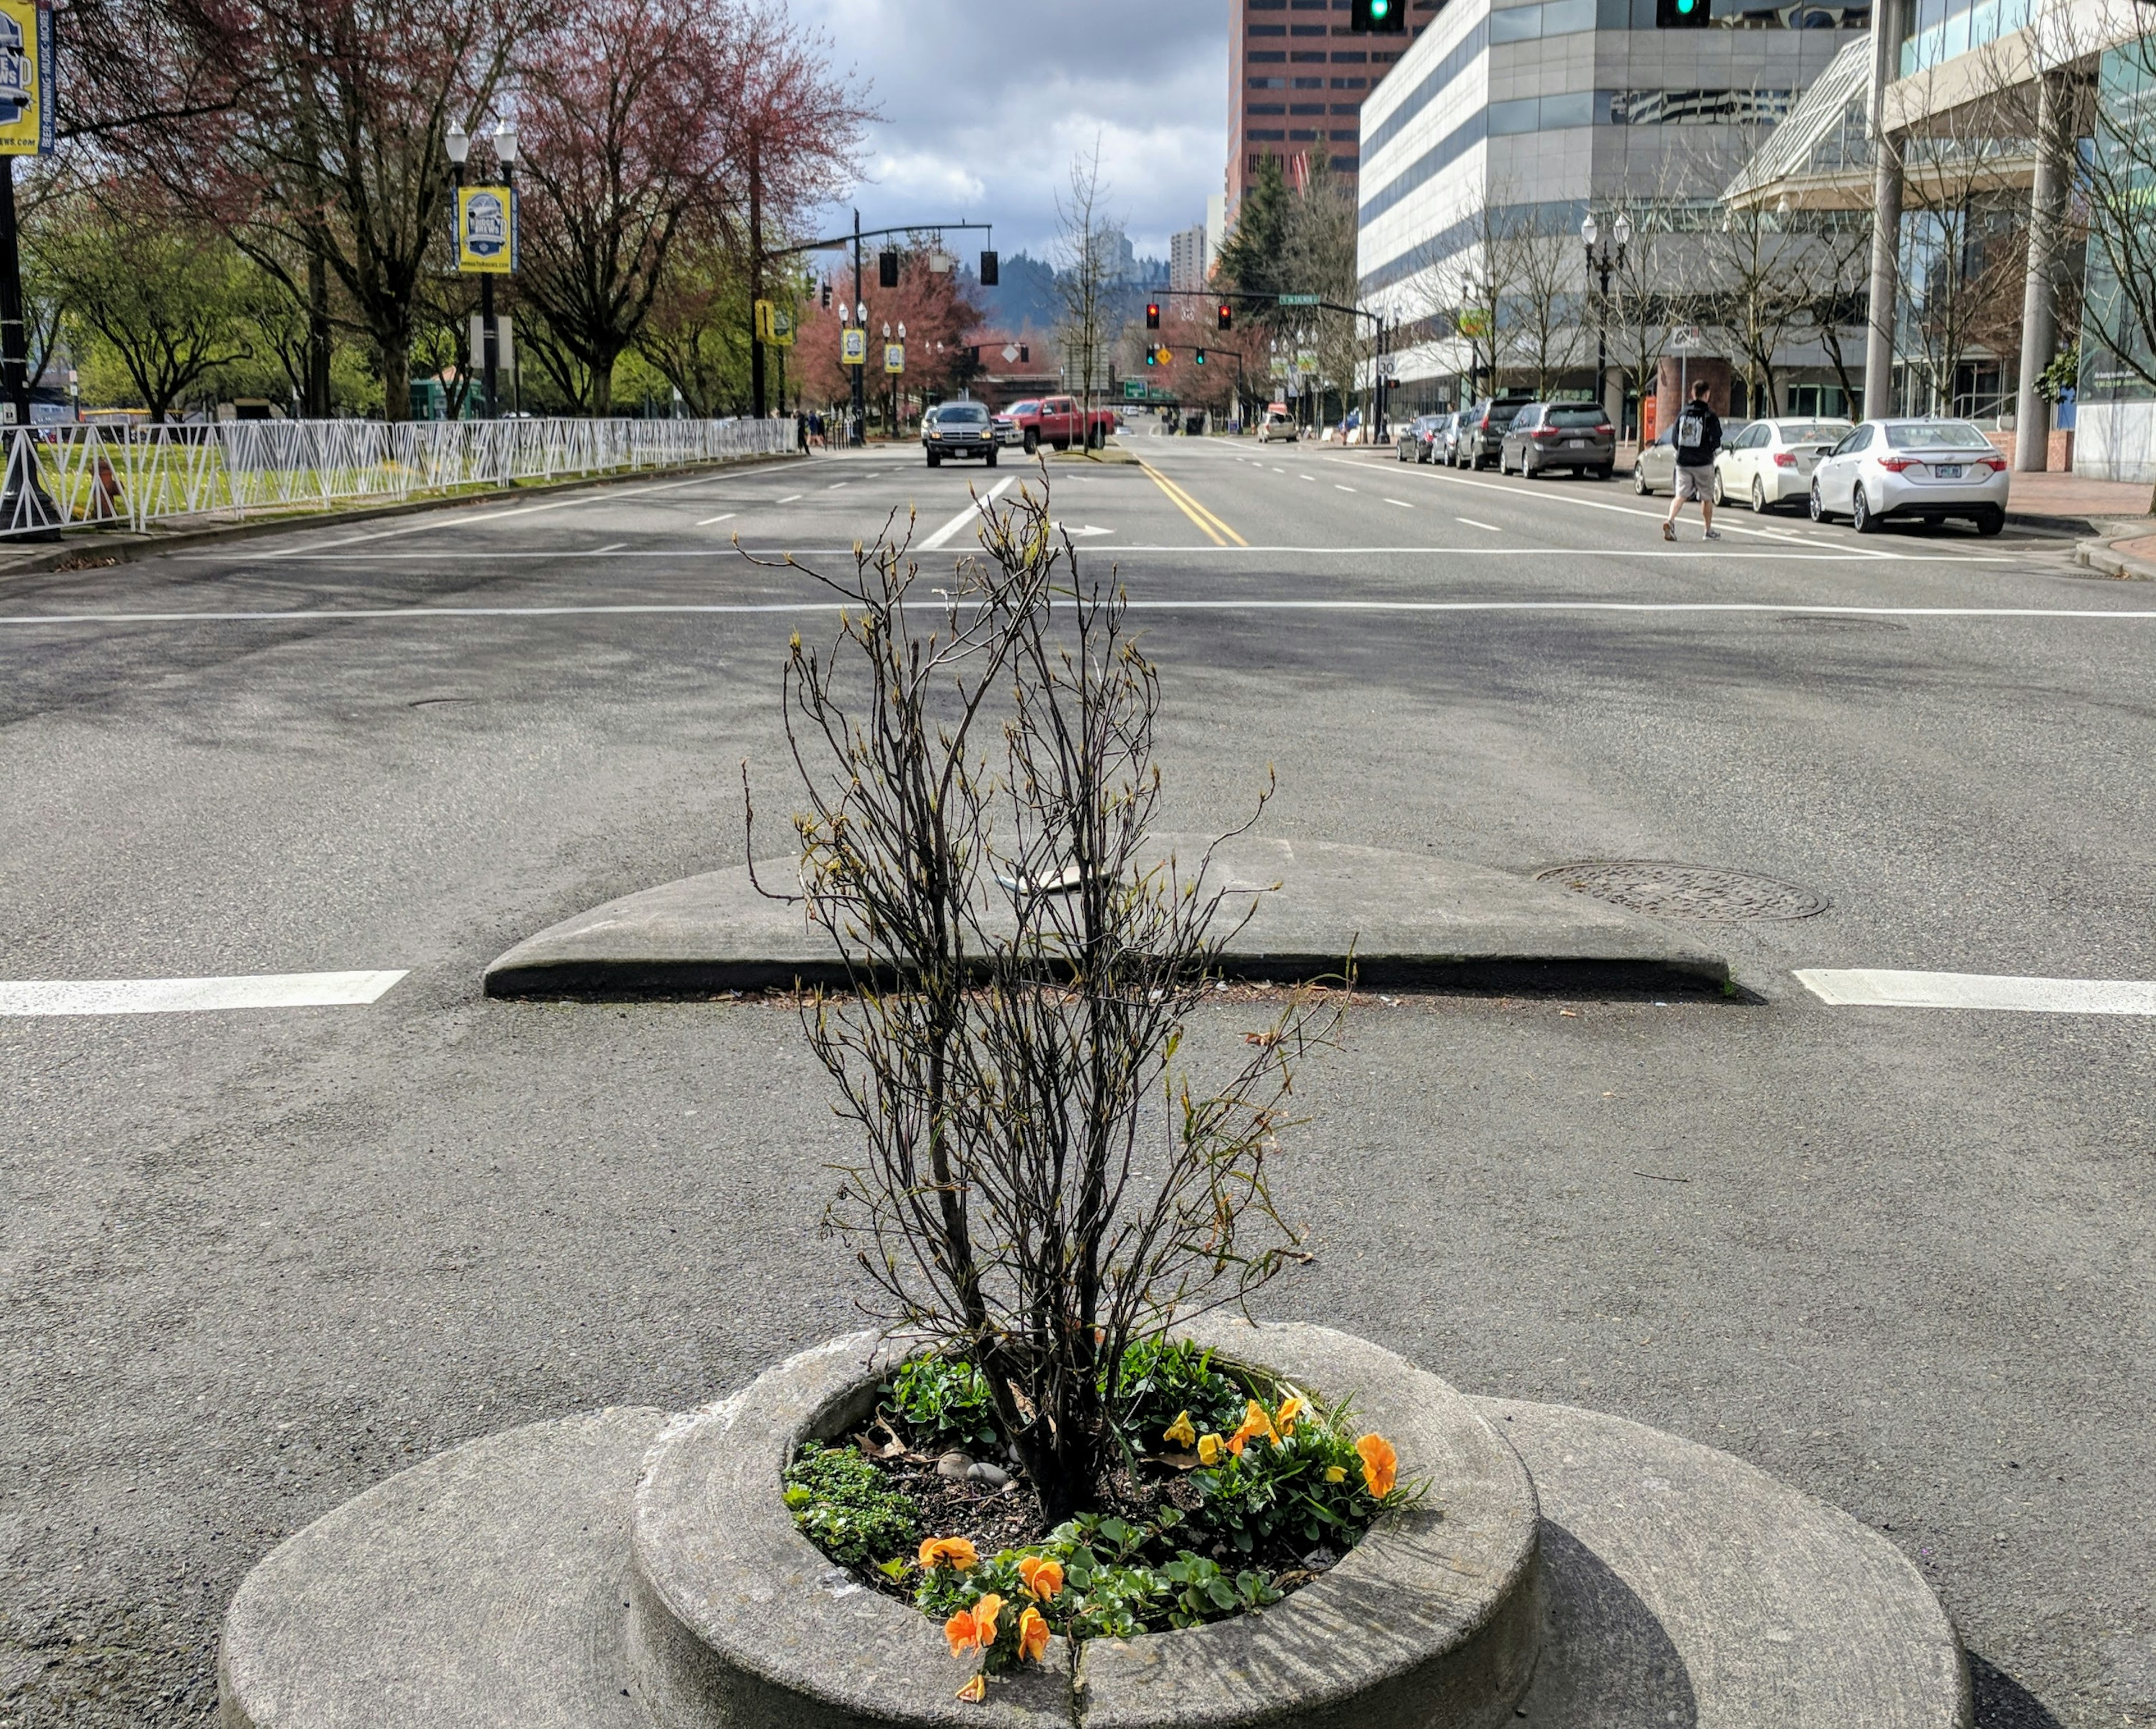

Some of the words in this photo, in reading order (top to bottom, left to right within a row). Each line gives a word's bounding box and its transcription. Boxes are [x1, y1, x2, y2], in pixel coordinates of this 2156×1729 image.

[41, 44, 51, 74] MUSIC
[42, 77, 52, 122] RUNNING
[41, 125, 52, 148] BEER
[1380, 362, 1394, 374] 30
